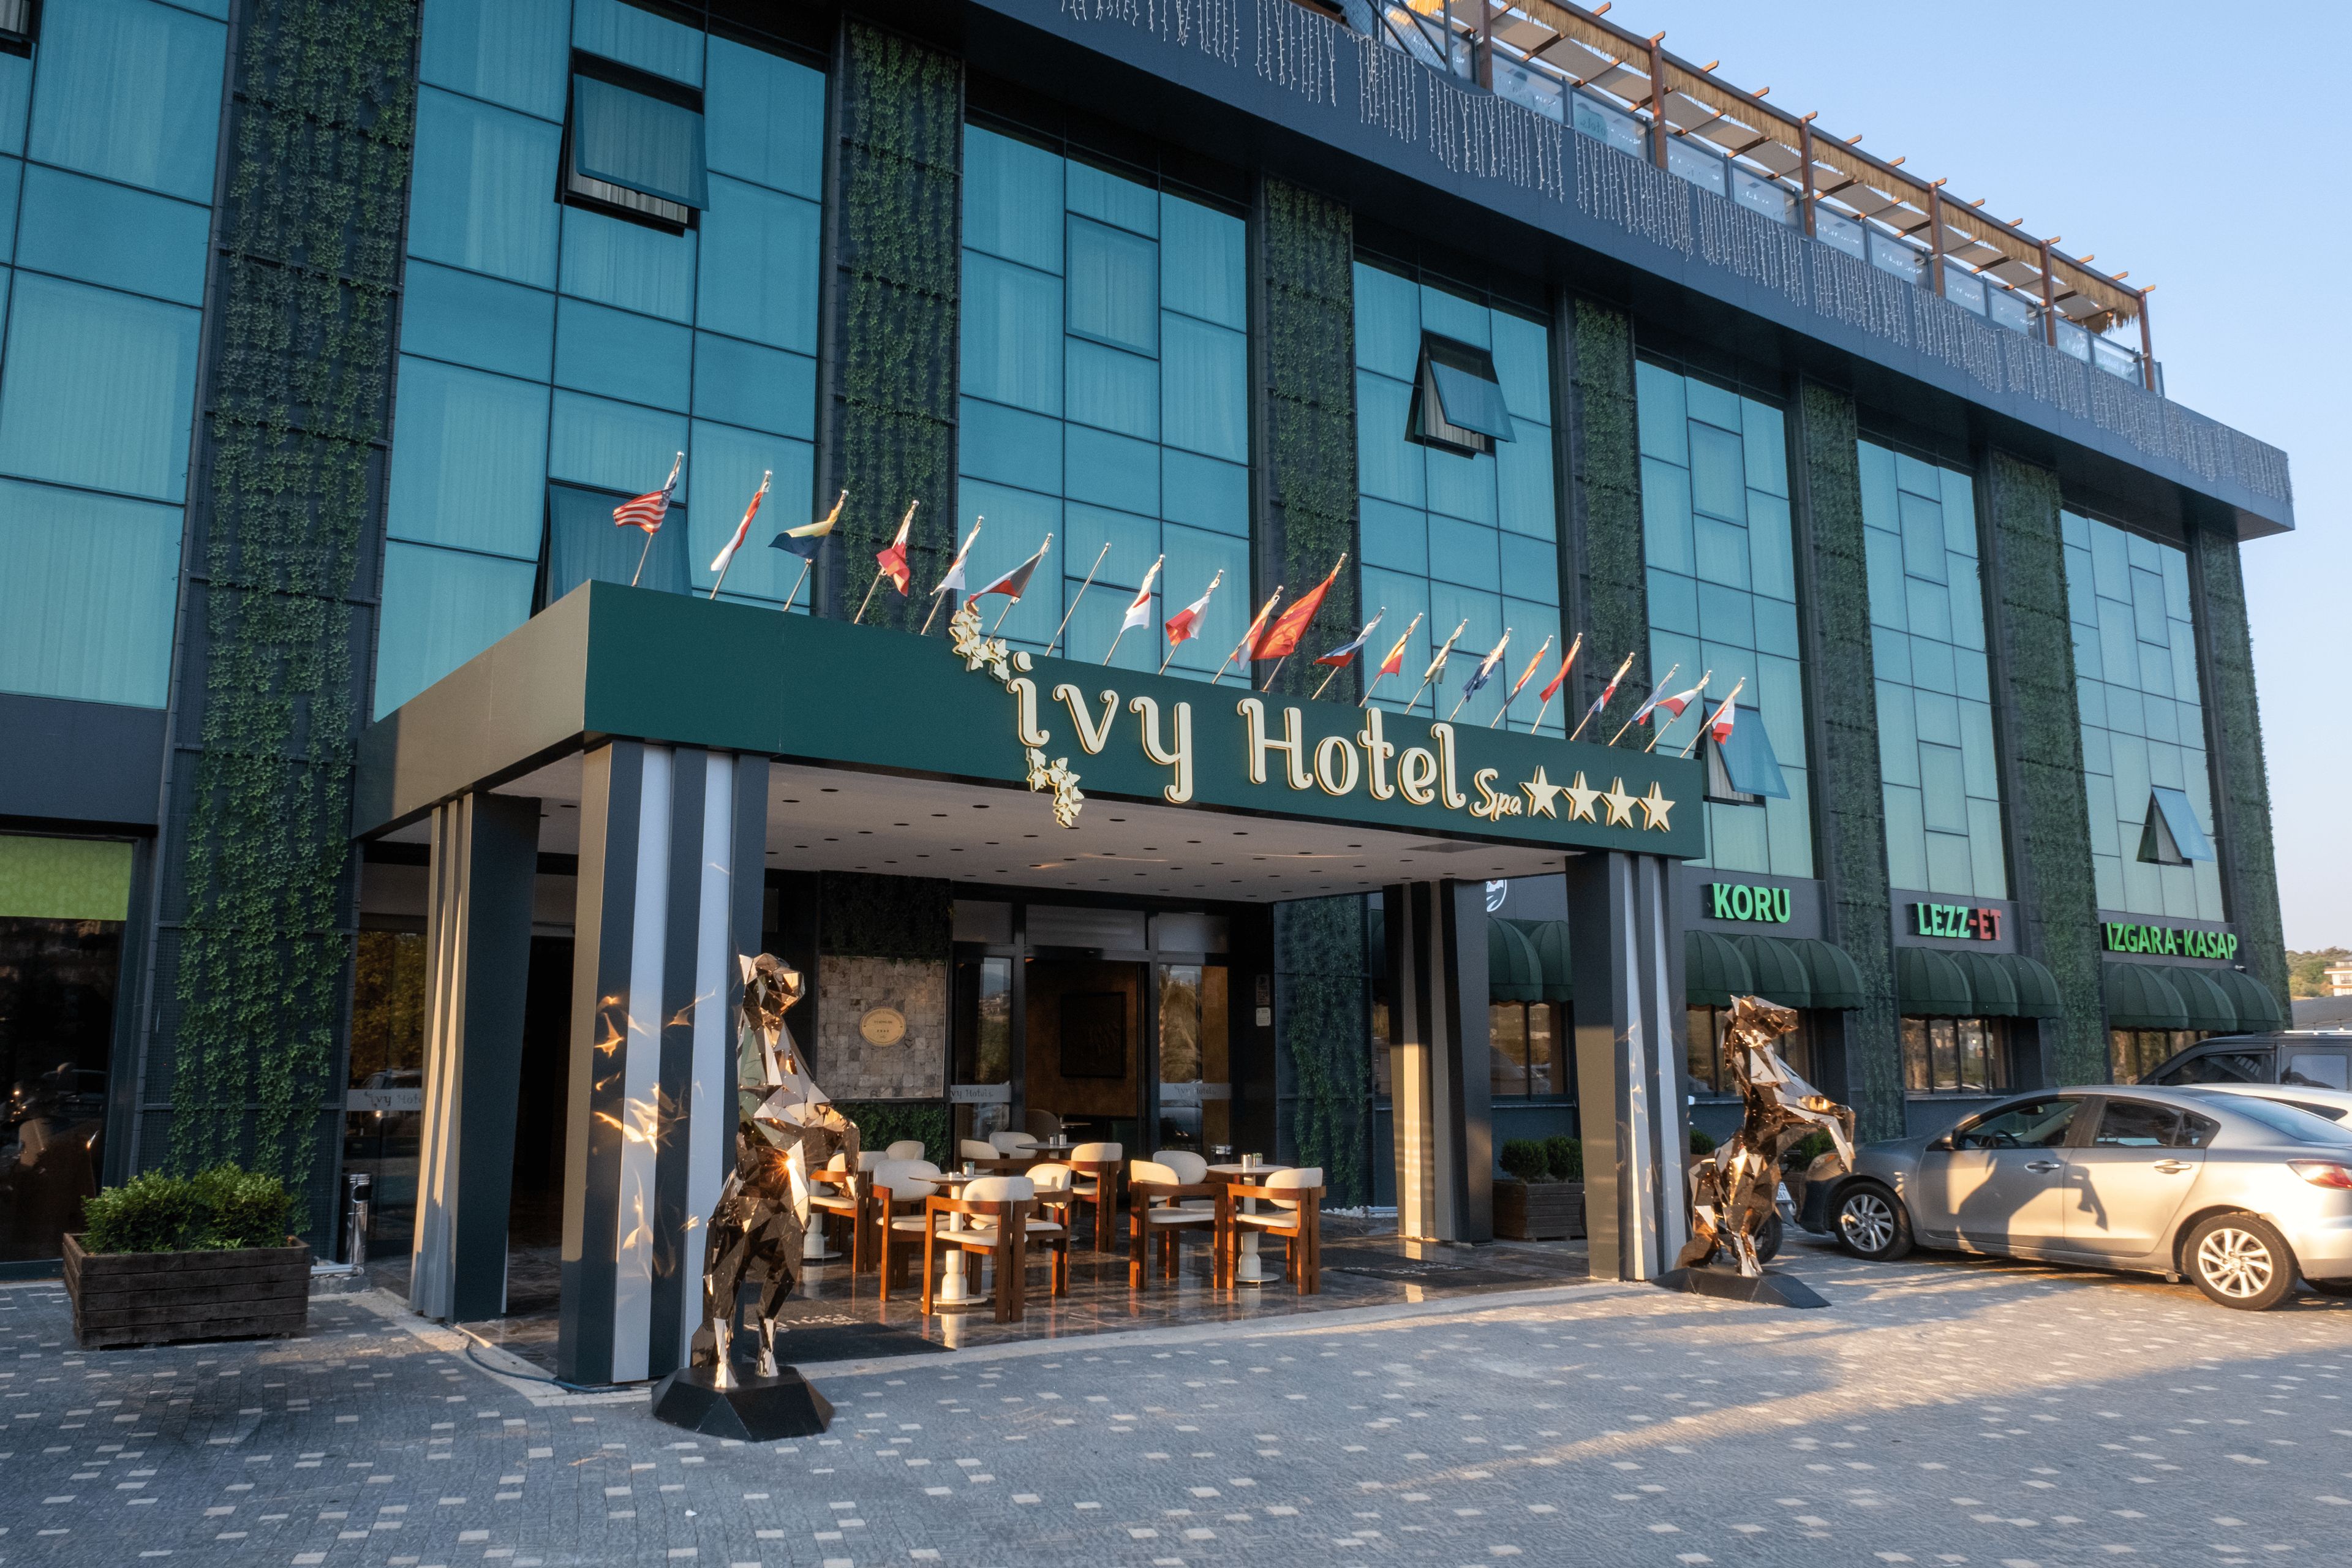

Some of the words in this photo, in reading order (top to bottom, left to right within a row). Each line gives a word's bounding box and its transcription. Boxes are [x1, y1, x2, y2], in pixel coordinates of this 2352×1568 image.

[1237, 698, 1466, 809] Hotel
[1469, 768, 1522, 821] Spa
[1713, 883, 1790, 923] KORU
[2106, 922, 2237, 960] IZGARA-KASAP
